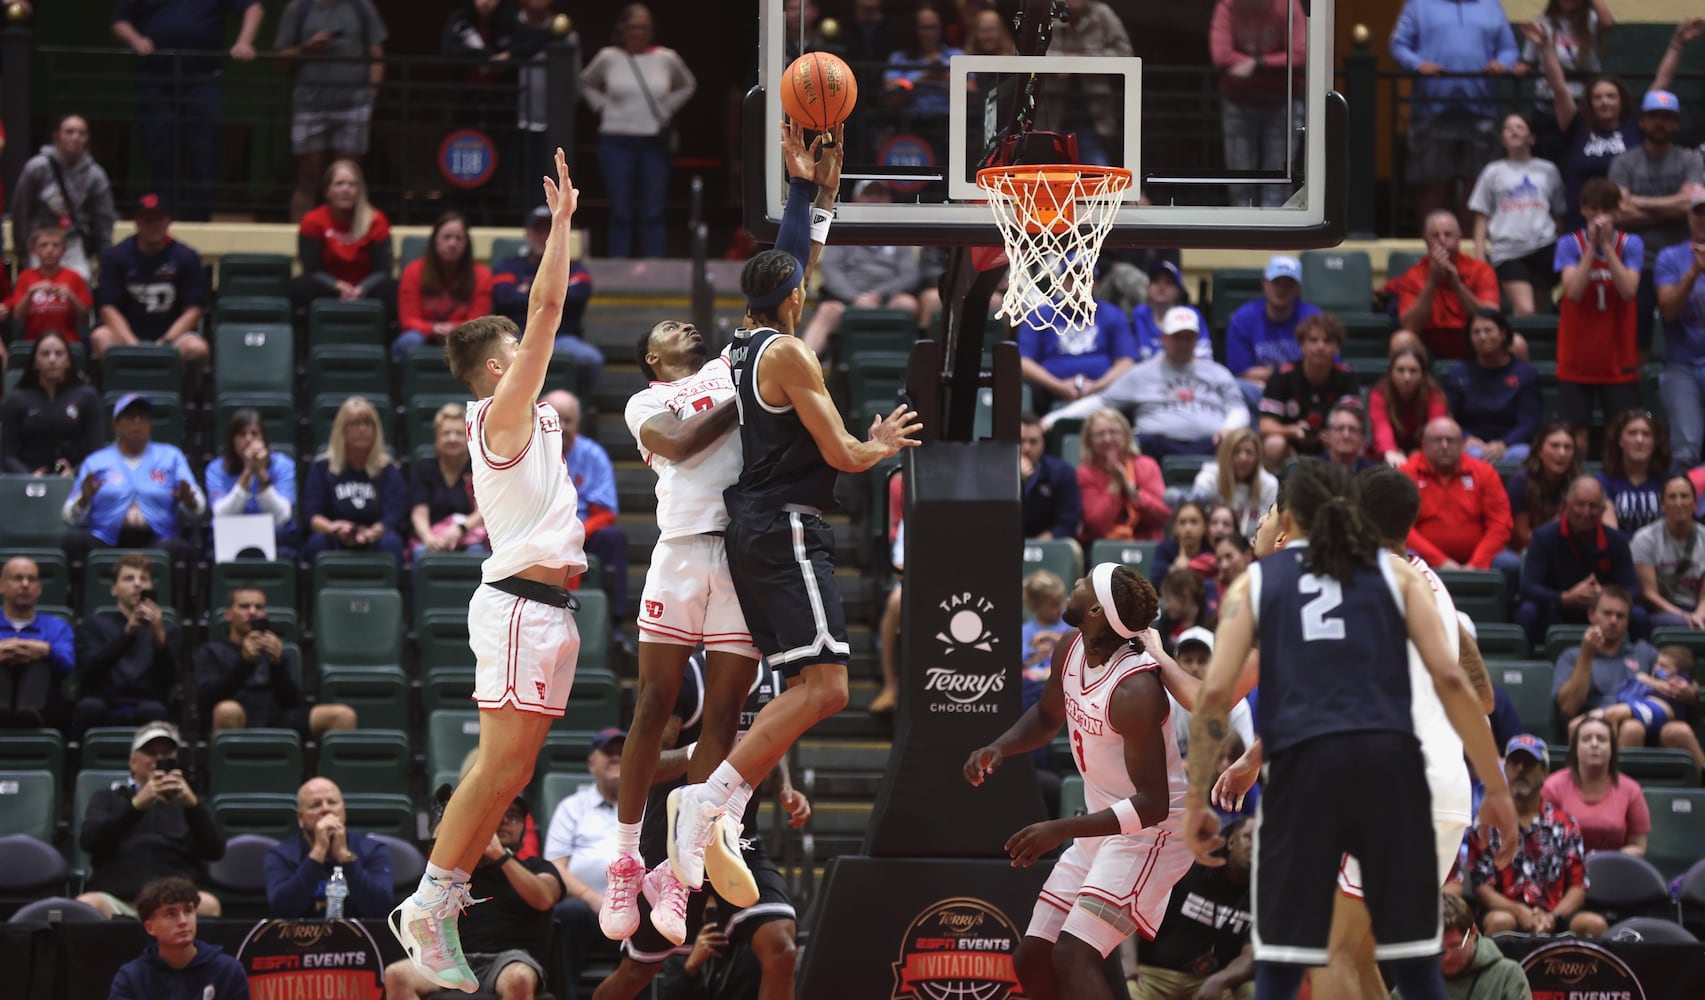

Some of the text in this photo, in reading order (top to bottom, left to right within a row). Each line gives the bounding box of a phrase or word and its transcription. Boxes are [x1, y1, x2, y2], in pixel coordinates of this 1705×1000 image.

[939, 592, 994, 612] TAP IT
[1298, 573, 1346, 642] 2
[930, 703, 998, 714] CHOCOLATE
[1073, 729, 1087, 773] 3
[915, 938, 1010, 950] ESPN EVENTS
[251, 951, 366, 970] ESPN EVENTS
[911, 954, 1012, 977] INVITATIONAL
[254, 974, 369, 1000] NVITATIONAL
[1568, 991, 1631, 1000] EVENTS
